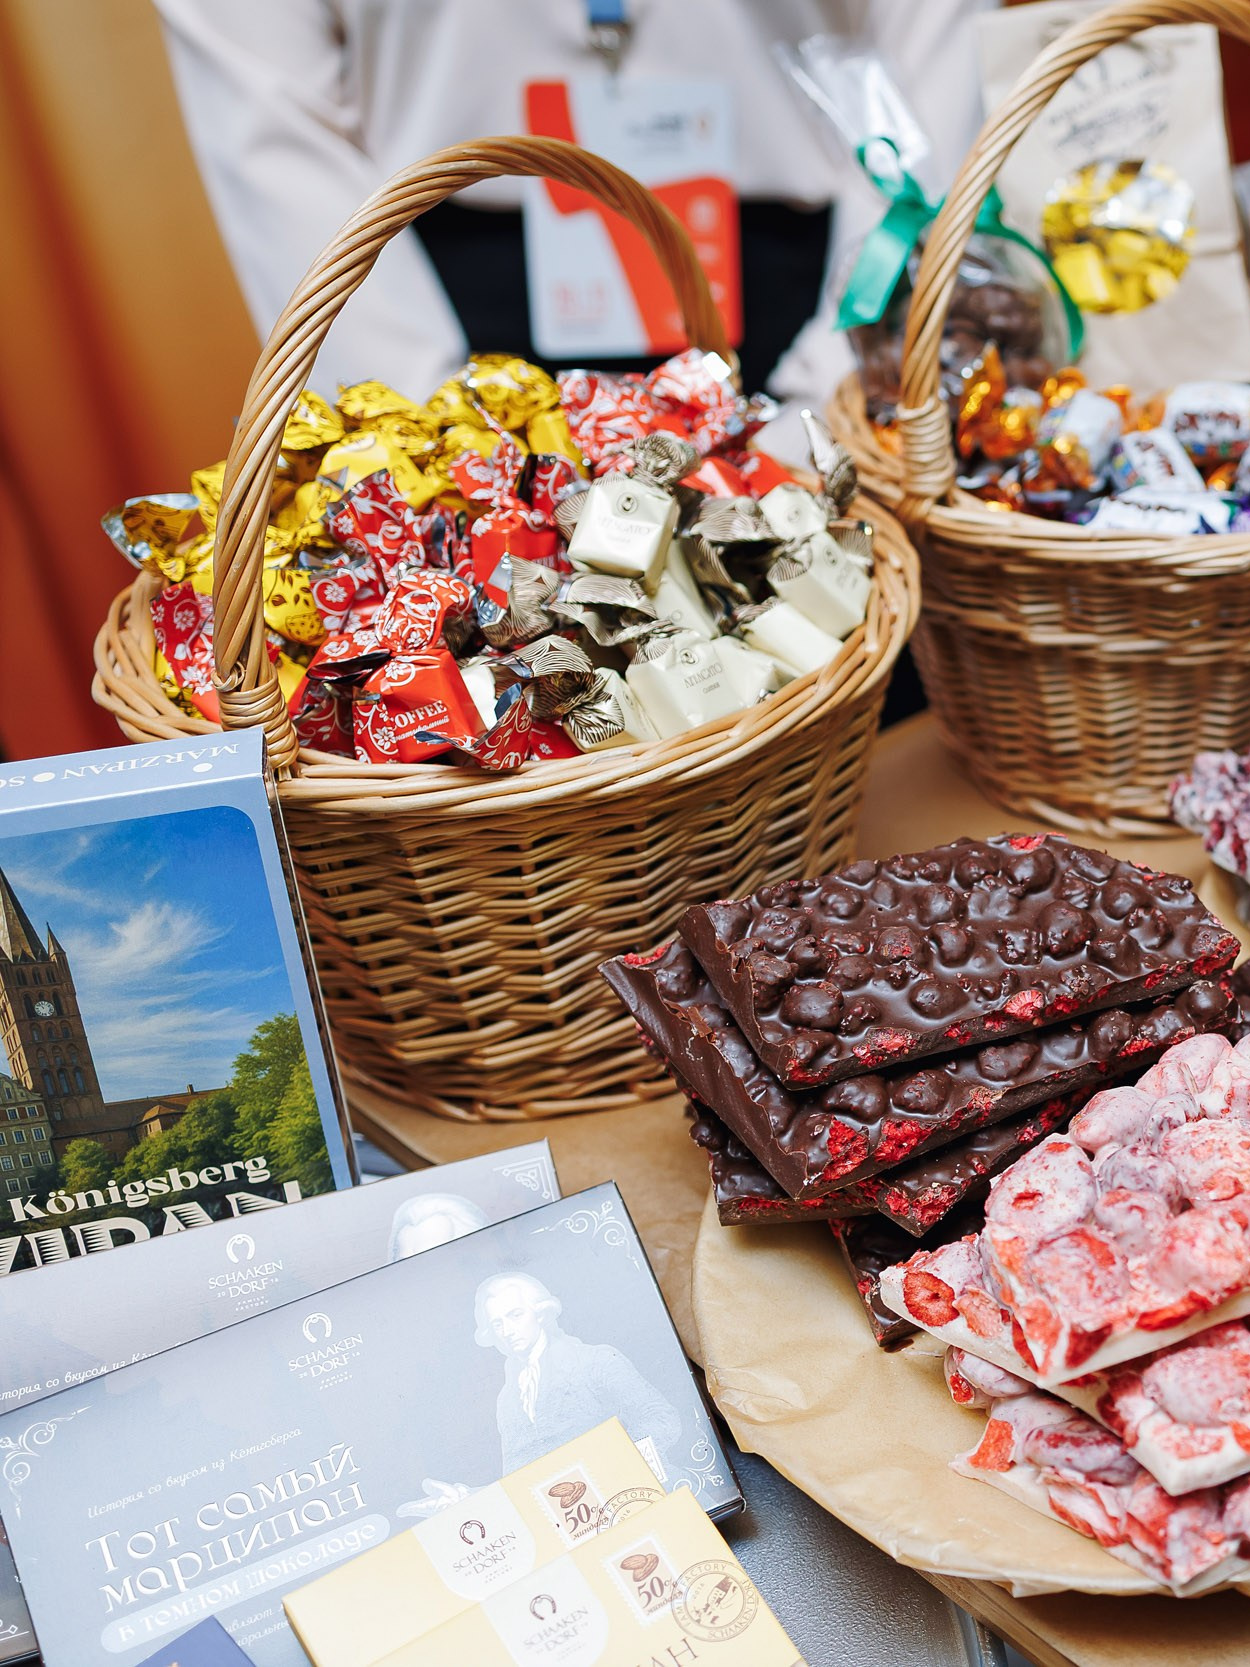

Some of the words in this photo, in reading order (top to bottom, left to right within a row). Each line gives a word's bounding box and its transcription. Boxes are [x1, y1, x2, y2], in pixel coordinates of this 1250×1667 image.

[60, 743, 240, 780] MARZIPAN
[7, 1155, 272, 1223] Königsberg
[208, 1259, 283, 1289] SCHAAKEN
[228, 1277, 269, 1298] DORF
[288, 1333, 363, 1372] SCHAAKEN
[310, 1352, 350, 1378] DORF
[0, 1383, 41, 1400] тория
[46, 1379, 60, 1388] со
[65, 1365, 108, 1384] вкусом
[88, 1491, 144, 1519] История
[148, 1483, 162, 1495] со
[166, 1464, 208, 1487] вкусом
[211, 1459, 226, 1472] из
[230, 1427, 303, 1462] Кёнигсберга
[85, 1516, 181, 1574] Тот
[196, 1441, 361, 1531] самый
[564, 1503, 604, 1534] 50%
[607, 1491, 653, 1513] FACTORY
[99, 1480, 367, 1614] марципан
[246, 1523, 377, 1590] шоколаде
[452, 1530, 517, 1573] SCHAAKEN
[473, 1548, 508, 1574] DORF
[637, 1576, 678, 1609] 50%
[680, 1564, 727, 1587] FACTORY
[225, 1608, 273, 1633] ивляют
